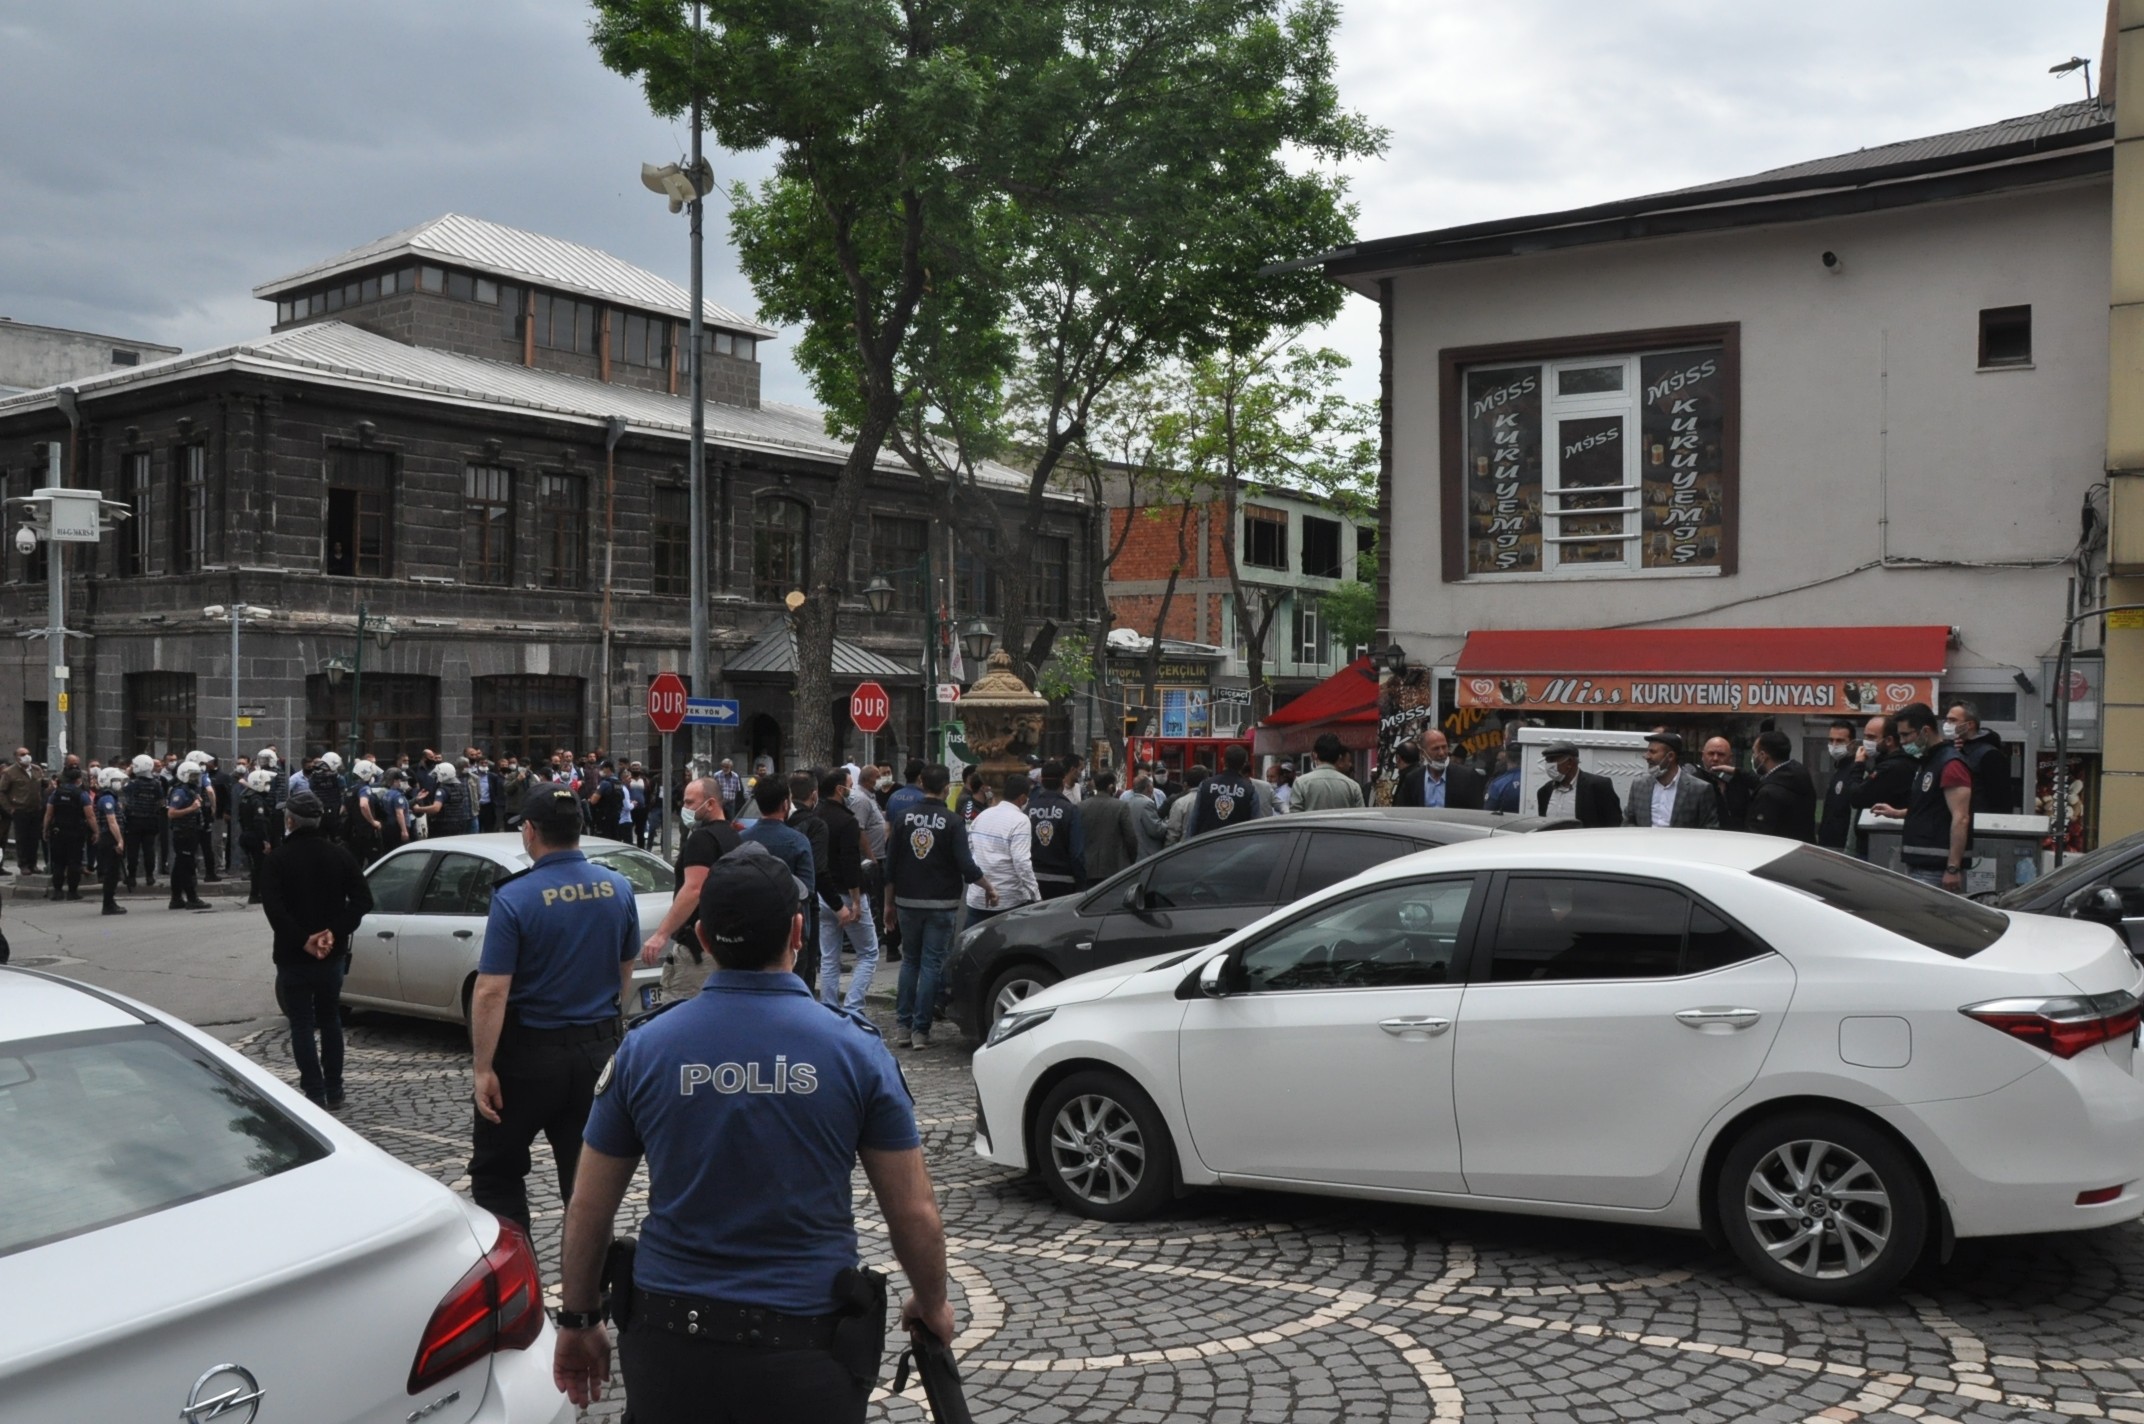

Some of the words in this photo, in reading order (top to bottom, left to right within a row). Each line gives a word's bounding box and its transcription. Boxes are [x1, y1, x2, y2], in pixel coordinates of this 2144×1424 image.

[1488, 413, 1523, 569] KURUYEMİŞ
[1663, 398, 1703, 563] KURUYEMİŞ
[651, 691, 683, 714] DUR
[1529, 678, 1625, 705] Miss
[1631, 680, 1742, 710] KURUYEMİŞ
[1748, 680, 1834, 706] DÜNYASI
[854, 698, 885, 717] DUR
[1210, 783, 1245, 798] POLİS
[905, 813, 947, 830] POLİS
[1029, 805, 1064, 819] POLİS
[542, 881, 615, 906] POLİS
[680, 1054, 818, 1096] POLİS
